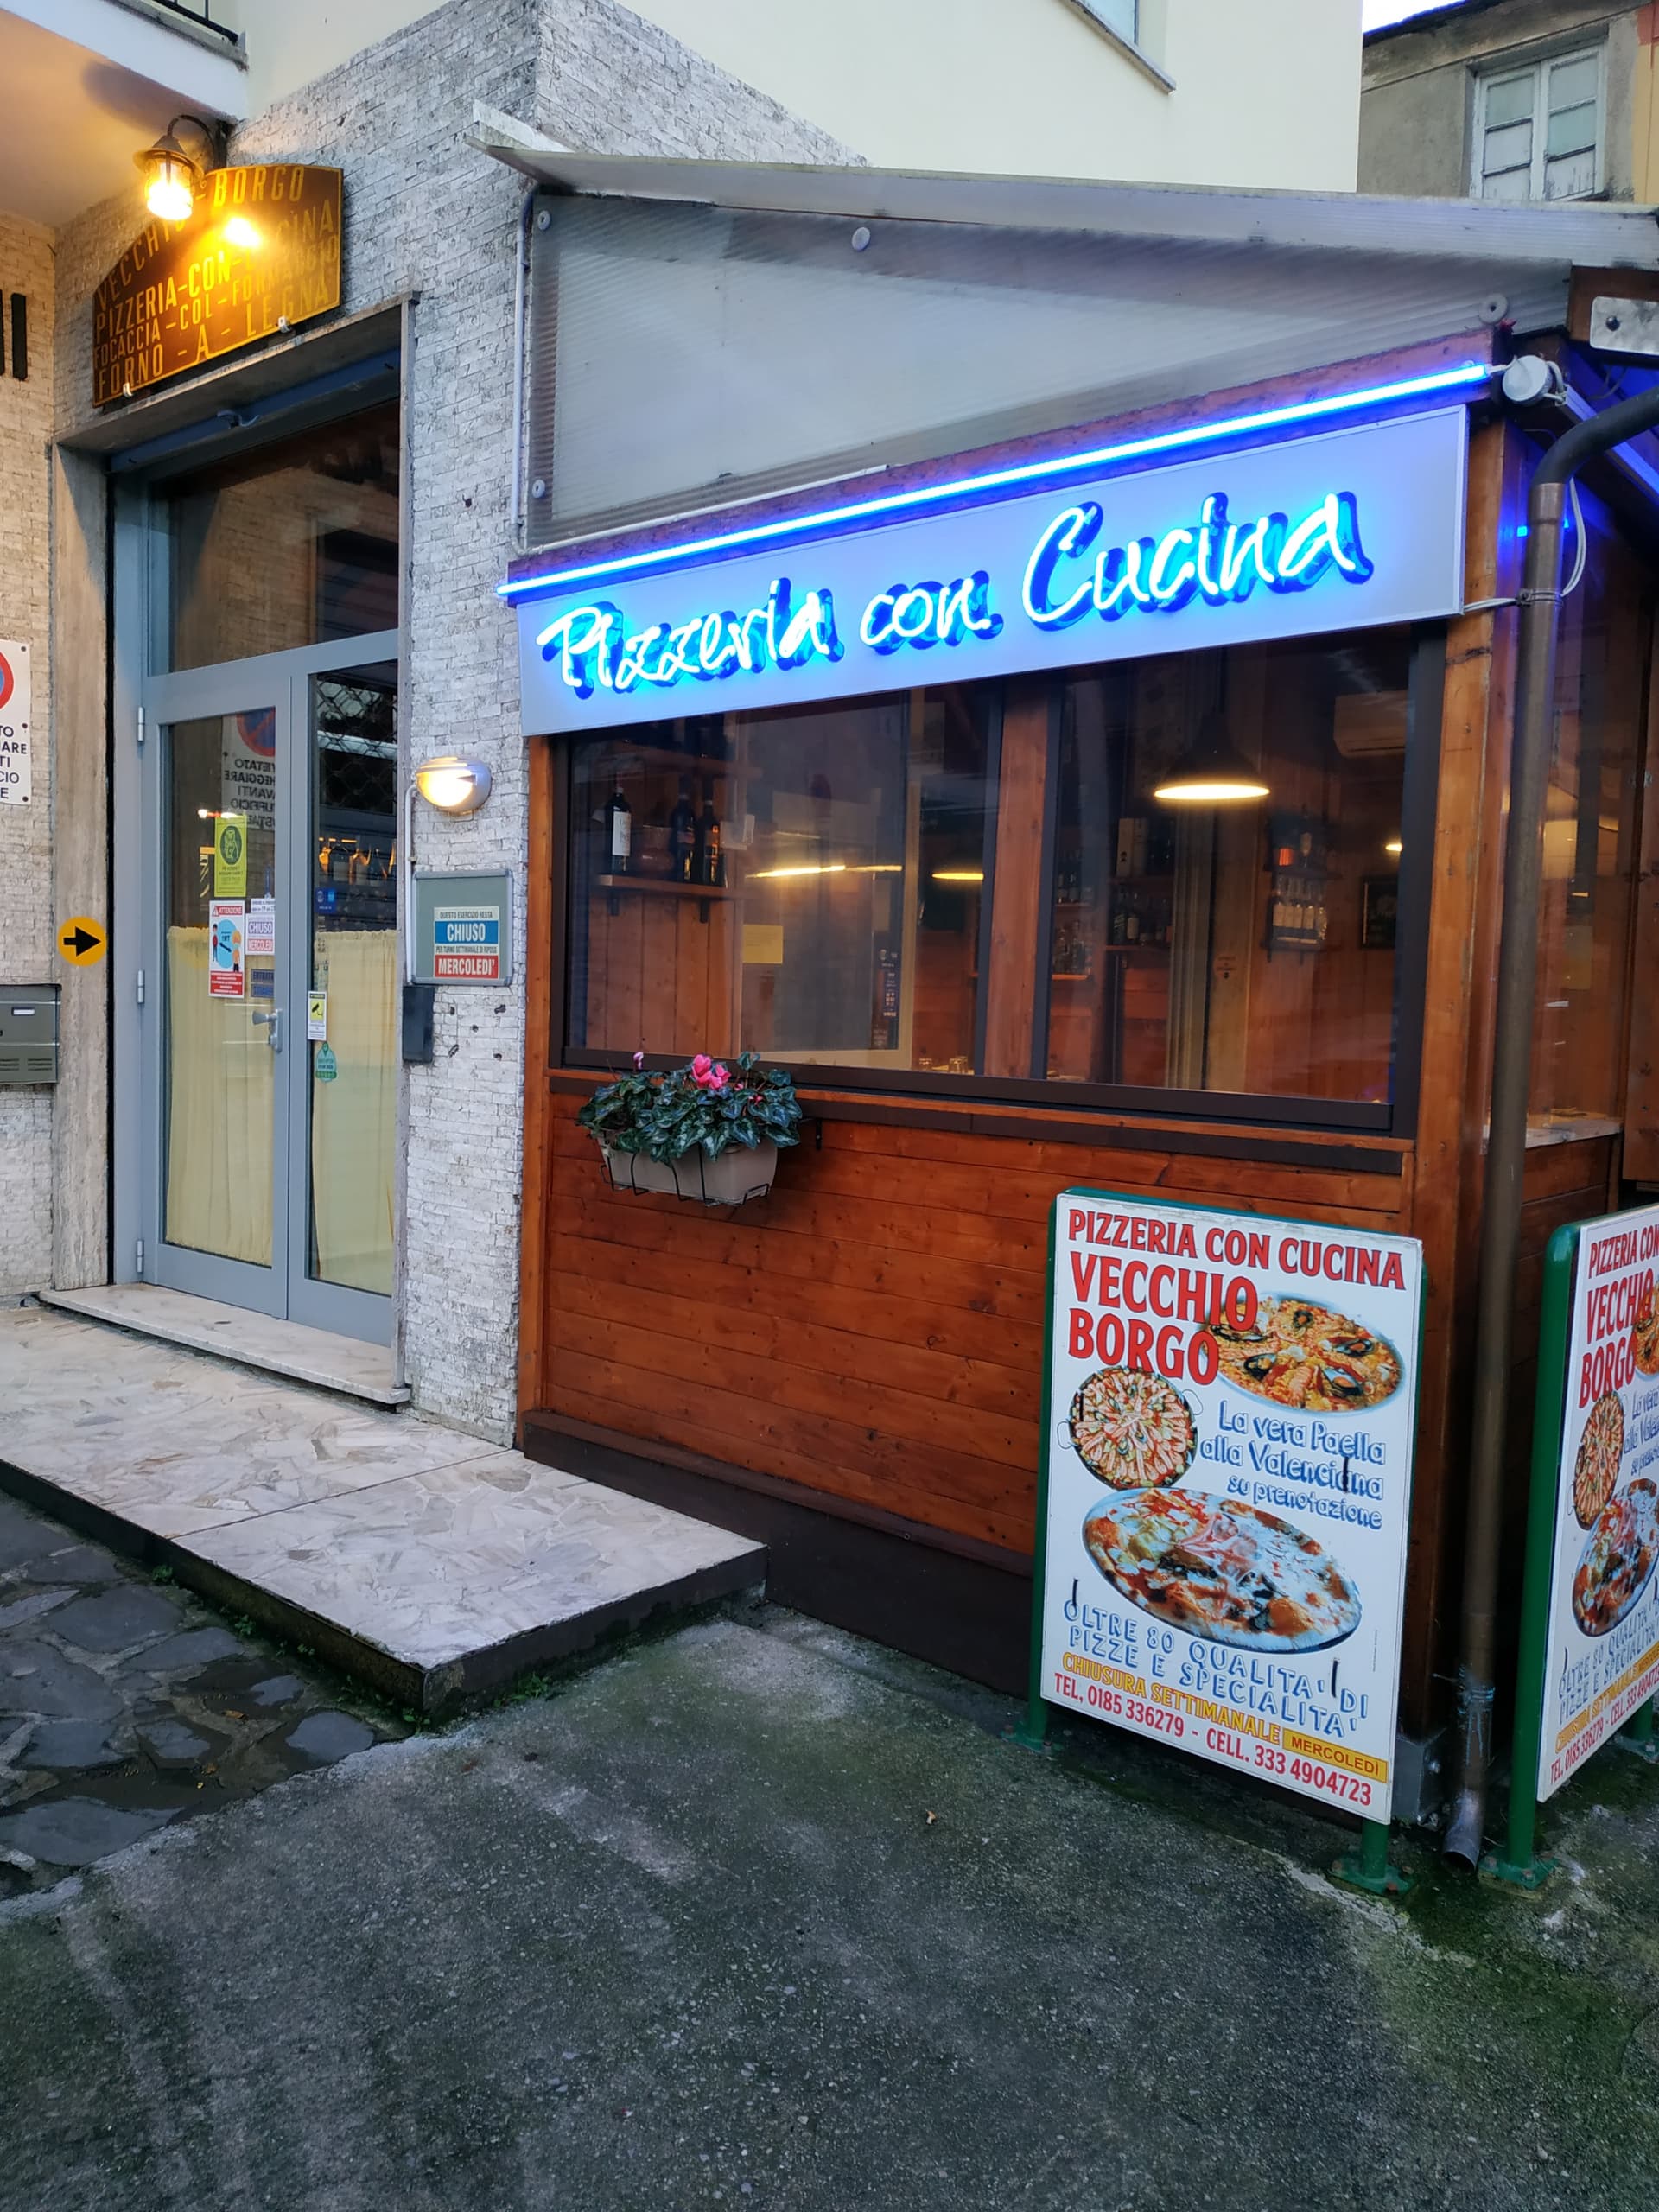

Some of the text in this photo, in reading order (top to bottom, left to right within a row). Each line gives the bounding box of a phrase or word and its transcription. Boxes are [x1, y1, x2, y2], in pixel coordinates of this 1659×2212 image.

[213, 166, 305, 207] BORGO
[94, 317, 161, 370] FOCACCIA
[180, 294, 213, 331] COL
[99, 343, 164, 400] FORNO
[196, 324, 210, 364] A
[246, 271, 329, 337] LEGNA
[537, 491, 1373, 699] Pizzeria con Cucina
[249, 923, 272, 933] CHIUSO
[447, 923, 486, 942] CHIUSO
[438, 957, 495, 976] MERCOLEDI'
[1068, 1209, 1407, 1291] PIZZERIA CON CUCINA
[1588, 1230, 1638, 1280] PIZZERIA
[1070, 1251, 1259, 1332] VECCHIO
[1587, 1268, 1654, 1345] VECCHIO
[1068, 1307, 1220, 1386] BORGO
[1579, 1337, 1638, 1408] BORGO
[1200, 1434, 1383, 1500] alla Valenciana
[1219, 1400, 1386, 1465] La vera Paella
[1227, 1475, 1382, 1529] su prenotazione
[1063, 1599, 1138, 1643] OLTRE
[1147, 1625, 1174, 1654] 80
[1340, 1688, 1369, 1719] DI
[1070, 1625, 1139, 1669] PIZZE
[1152, 1654, 1166, 1678] E
[1062, 1651, 1147, 1699] CHIUSURA
[1151, 1681, 1281, 1745] SETTIMANALE
[1088, 1685, 1122, 1715] 0185
[1125, 1699, 1185, 1738] 336279
[1206, 1728, 1250, 1763] CELL.
[1254, 1745, 1286, 1775] 333
[1290, 1758, 1372, 1806] 4904723
